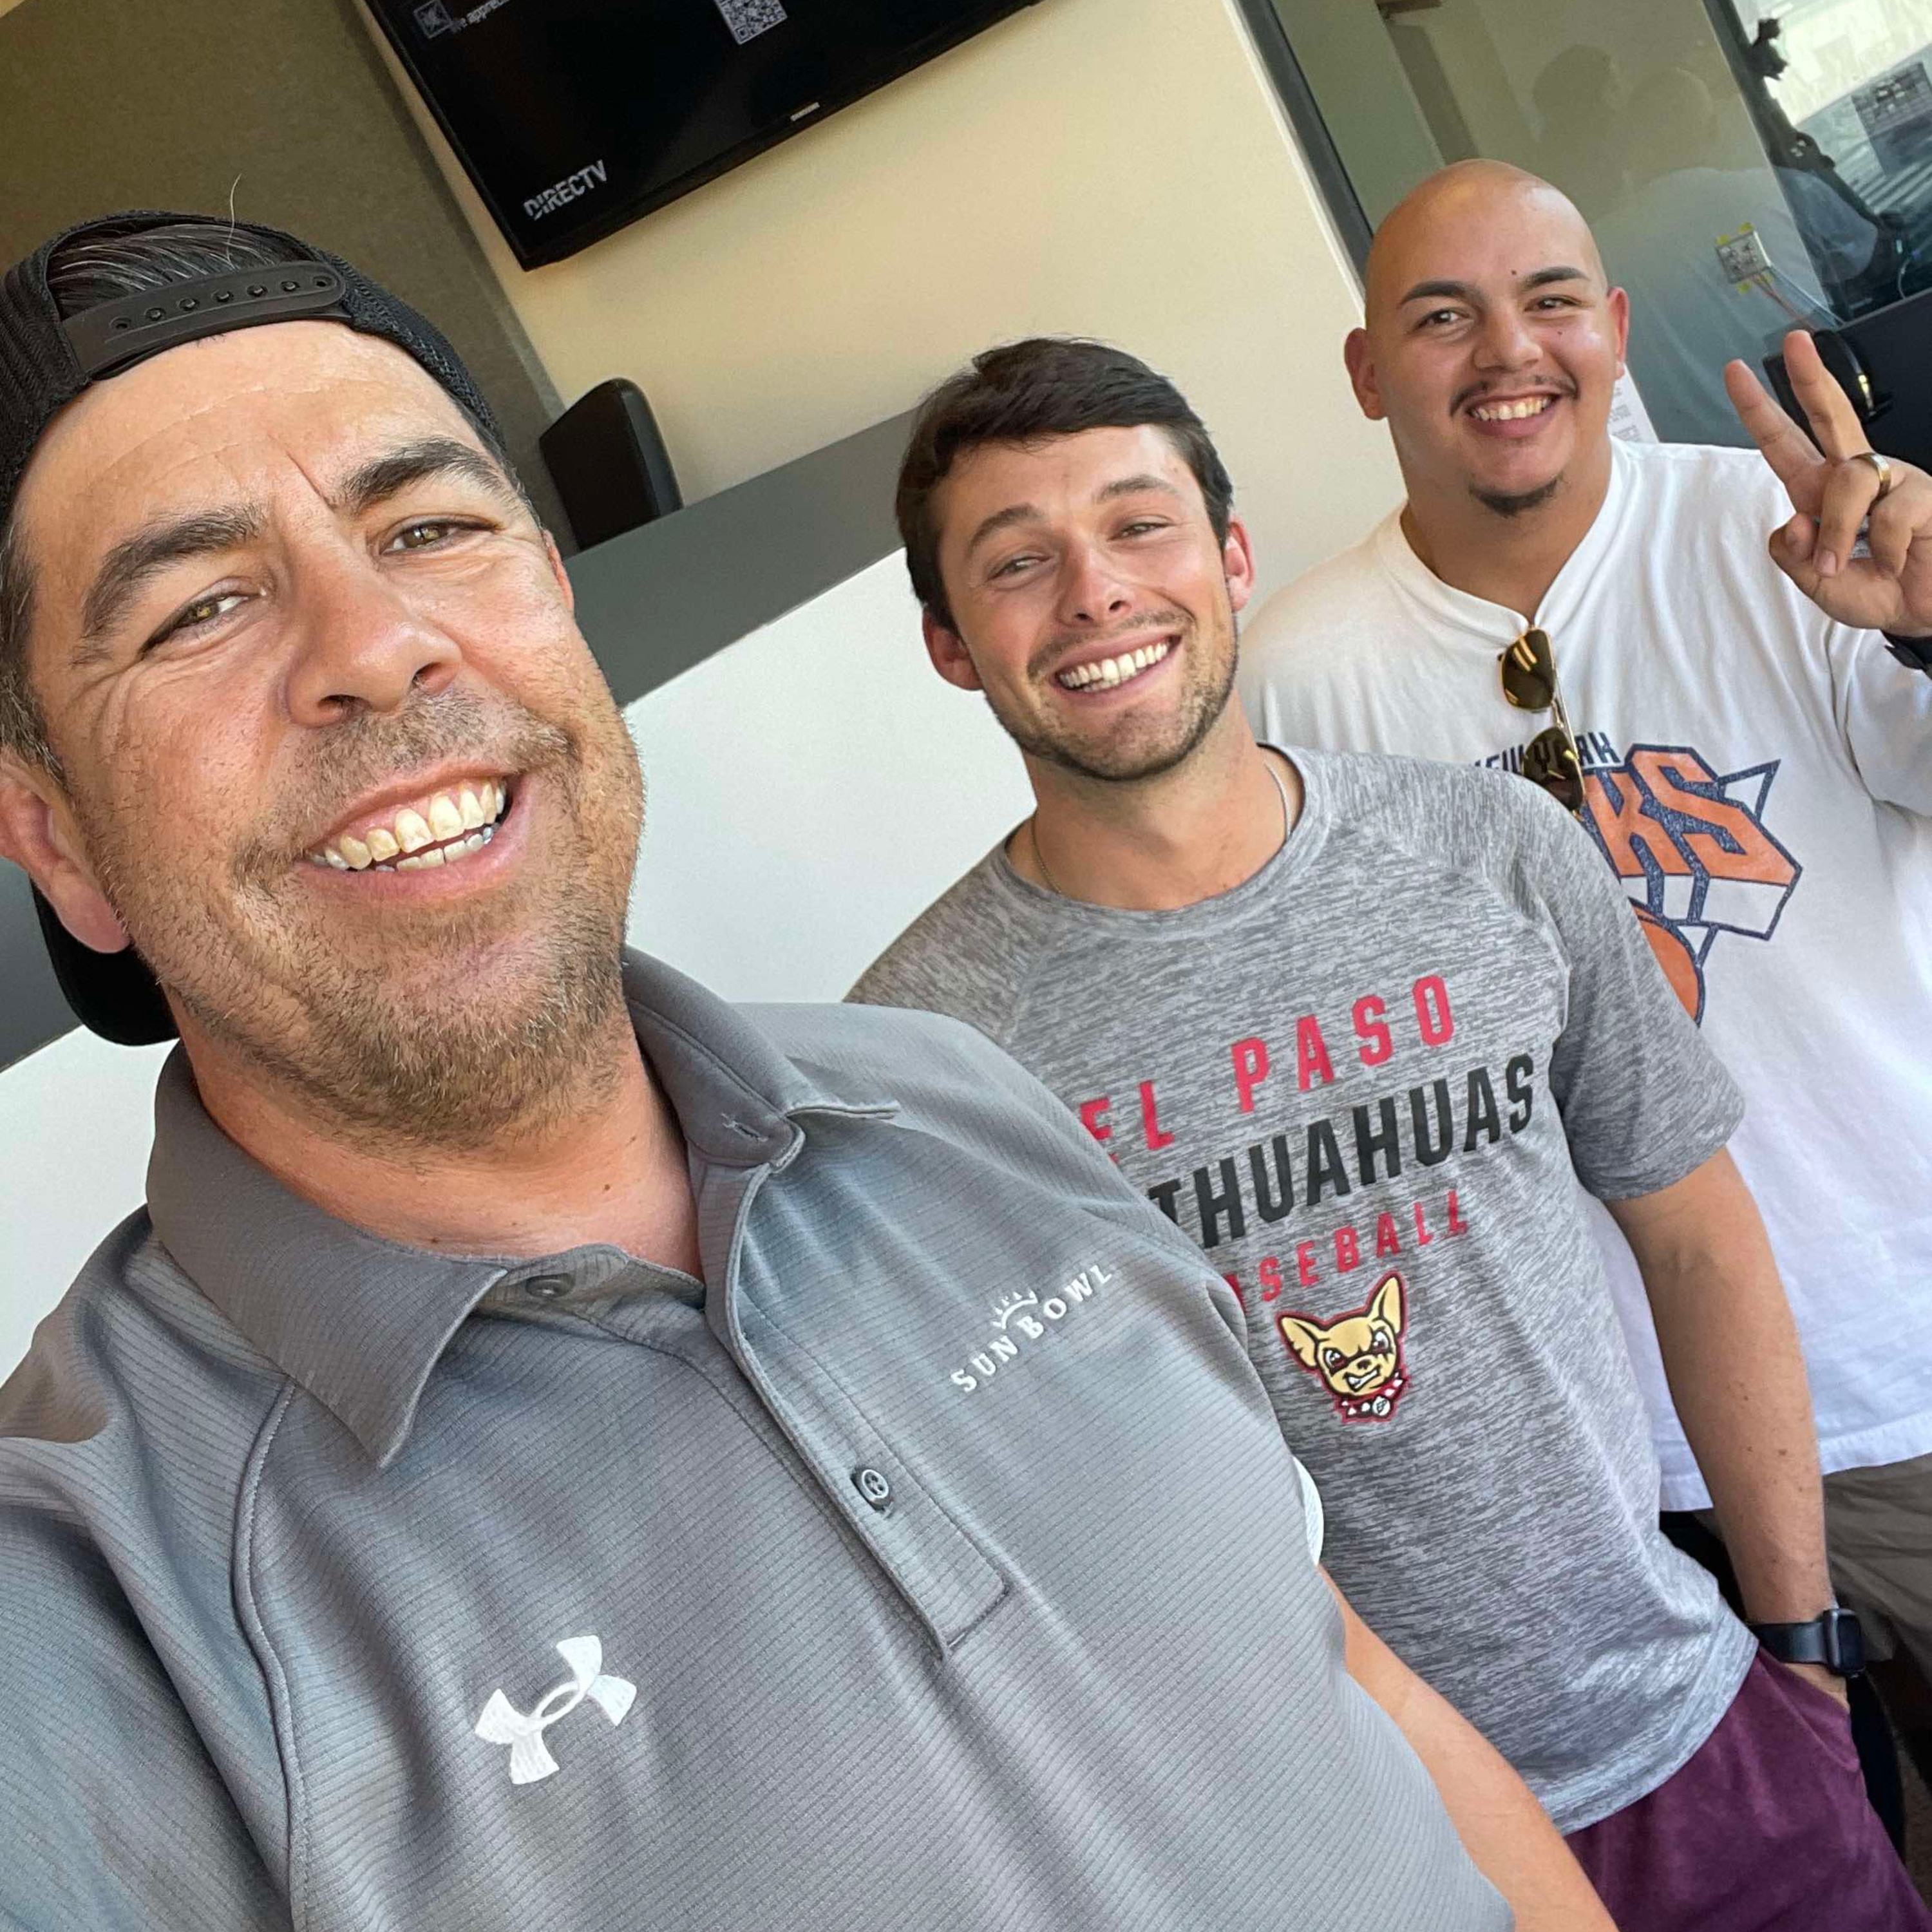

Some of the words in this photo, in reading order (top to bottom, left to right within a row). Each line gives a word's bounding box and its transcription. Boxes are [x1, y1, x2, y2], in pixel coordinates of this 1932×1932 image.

[524, 159, 607, 221] DIRECTV
[1081, 1081, 1175, 1165] EL
[1232, 975, 1454, 1113] PASO
[950, 1335, 1018, 1393] SUN
[1016, 1264, 1113, 1340] BOWL
